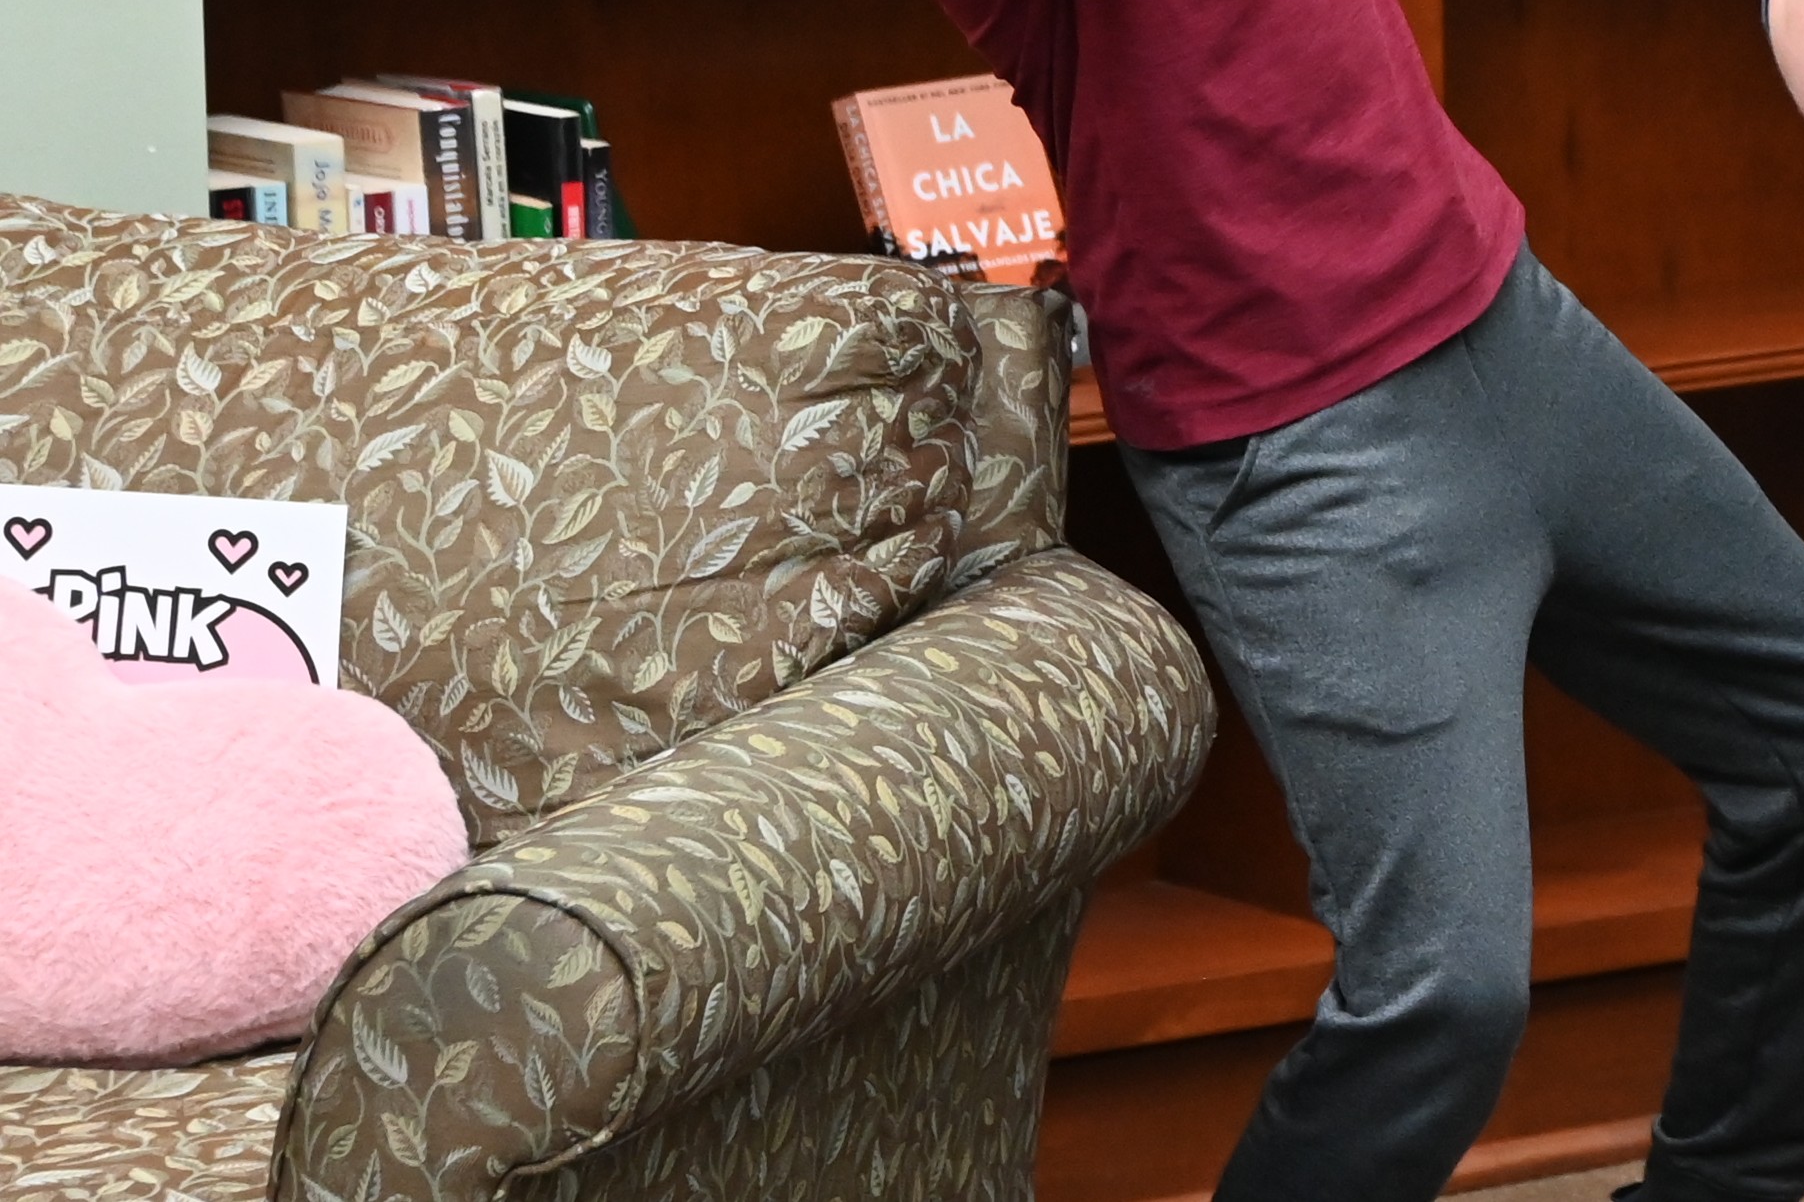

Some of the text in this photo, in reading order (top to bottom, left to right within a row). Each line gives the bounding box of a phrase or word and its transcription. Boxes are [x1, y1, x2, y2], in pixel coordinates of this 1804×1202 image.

[929, 112, 976, 144] LA
[912, 160, 1024, 201] CHICA
[906, 210, 1056, 261] SALVAJE
